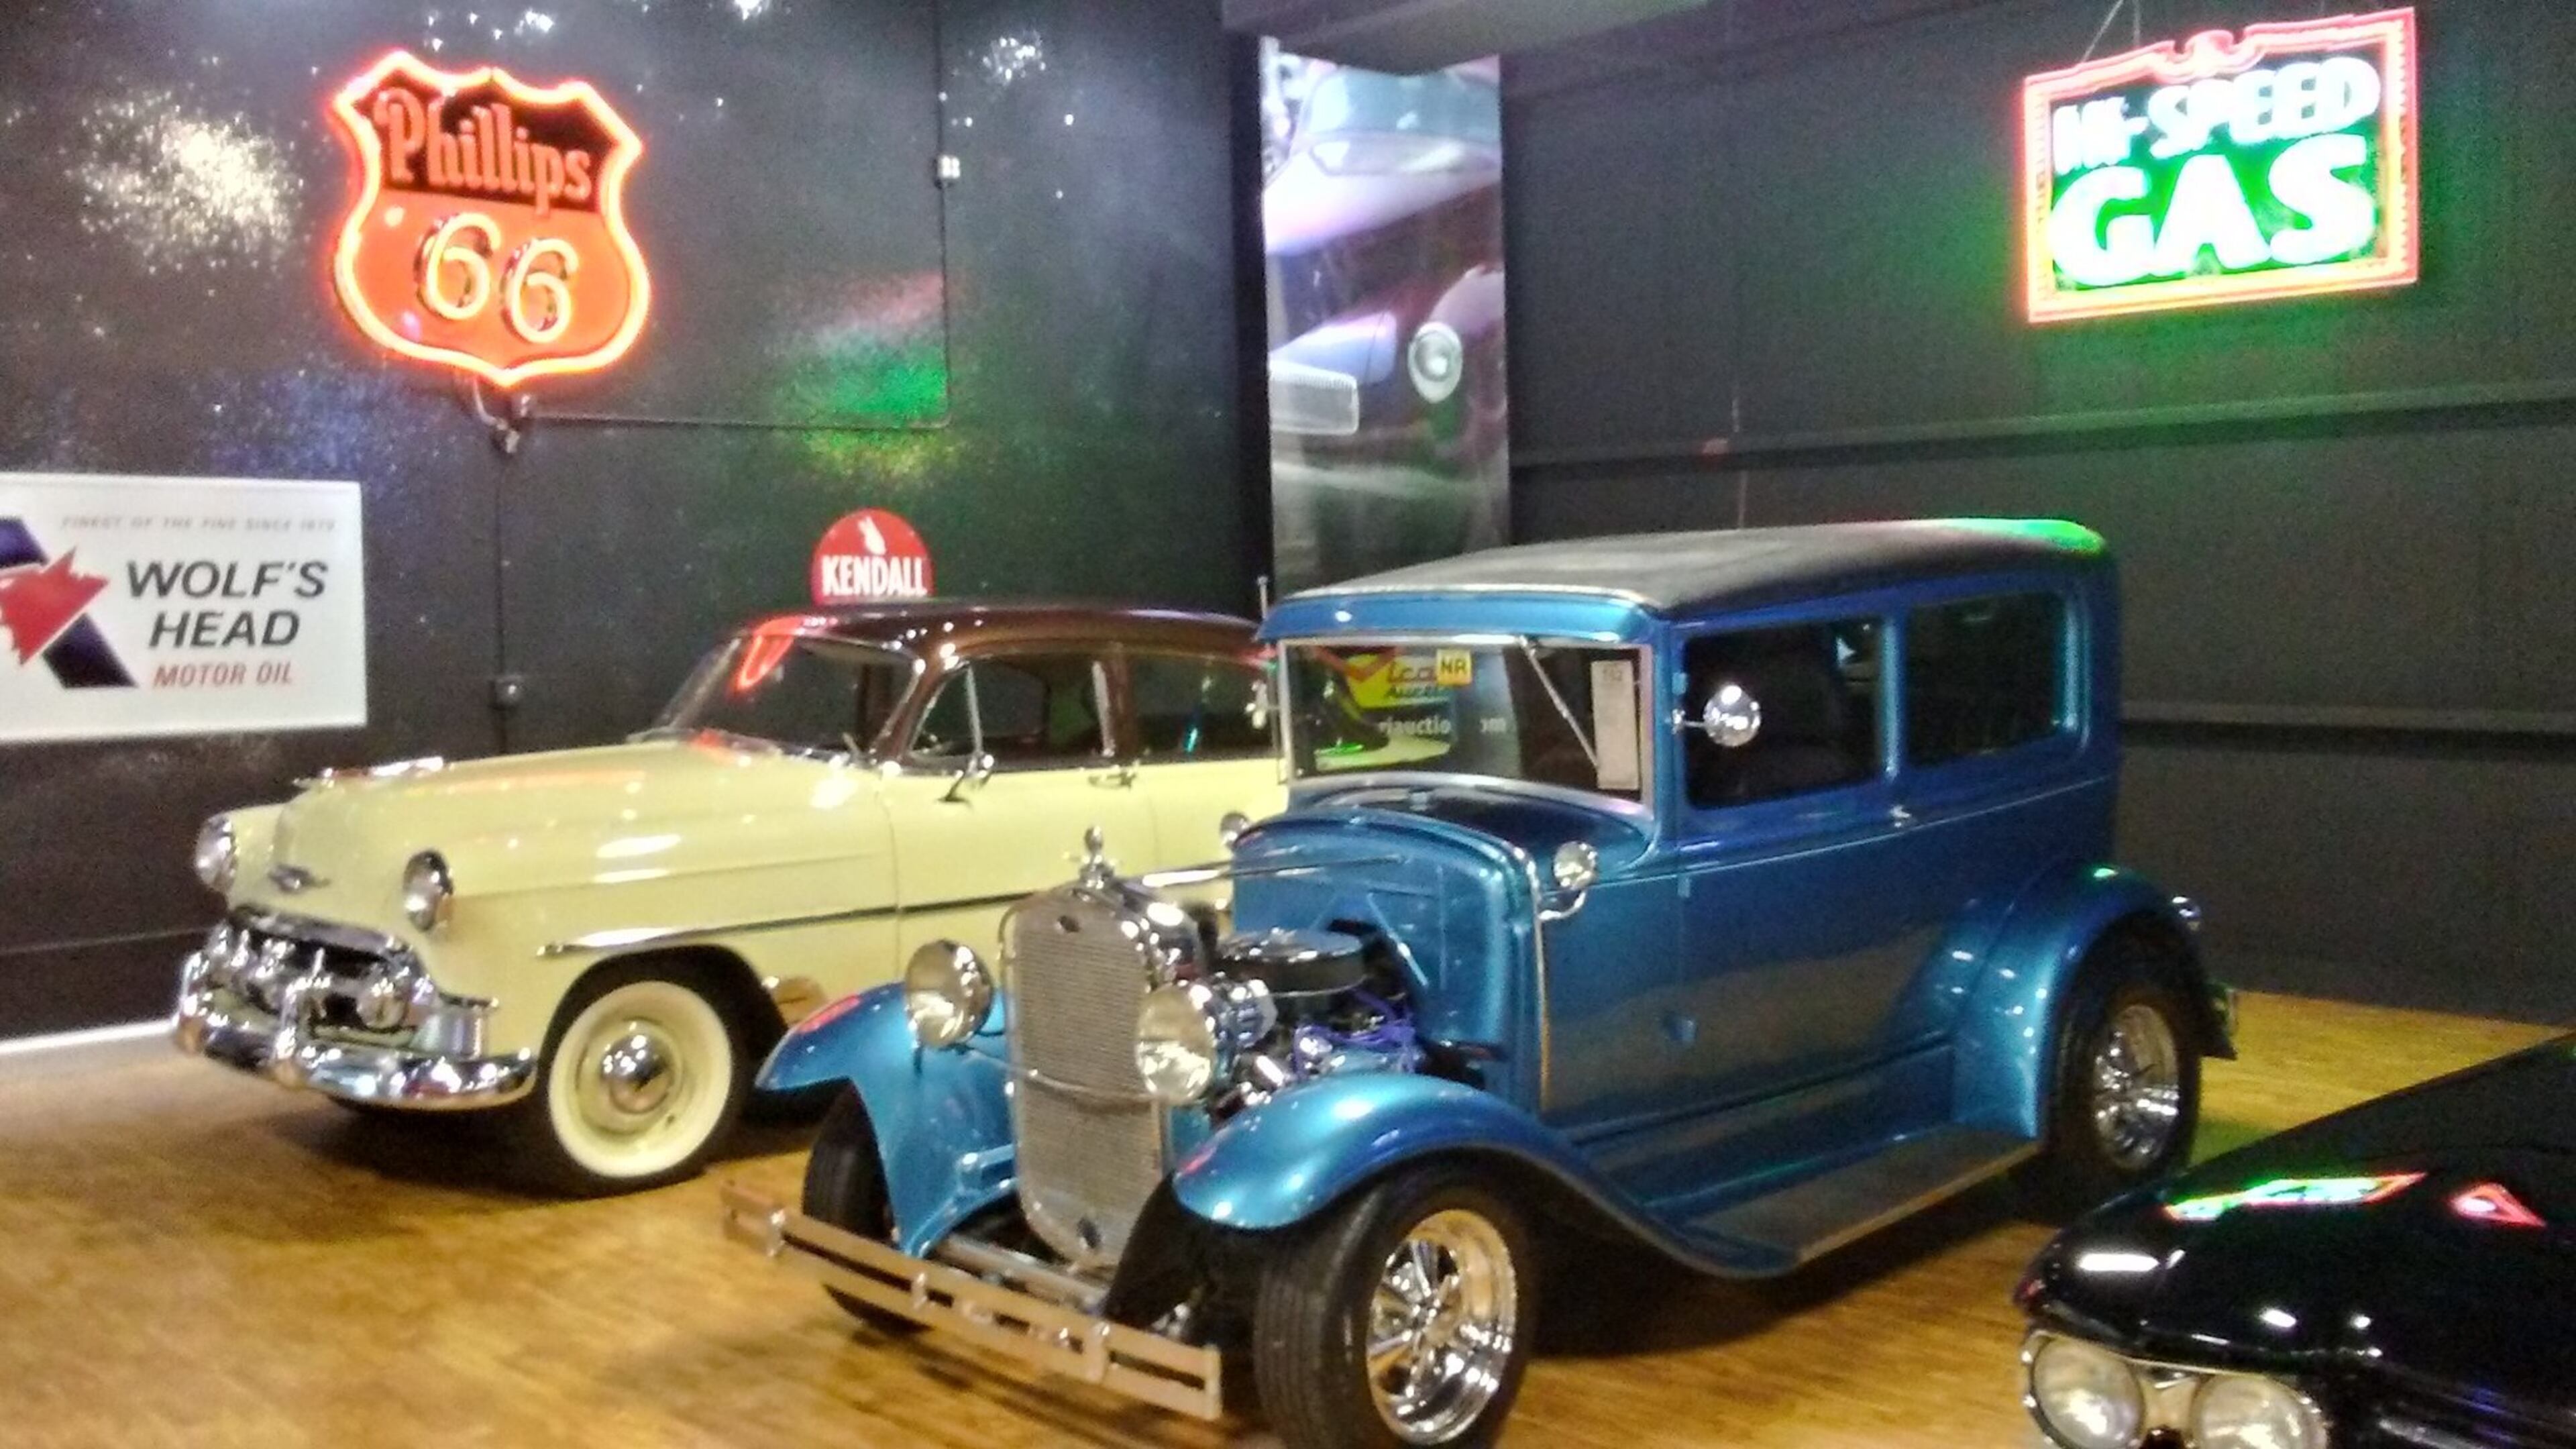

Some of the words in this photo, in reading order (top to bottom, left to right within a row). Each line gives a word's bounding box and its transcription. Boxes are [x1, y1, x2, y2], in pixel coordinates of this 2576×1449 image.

[373, 87, 592, 219] Phillips
[2048, 133, 2376, 286] GAS
[415, 211, 580, 343] 66
[127, 559, 329, 599] WOLF'S
[822, 554, 928, 598] KENDALL
[148, 610, 301, 649] HEAD
[152, 661, 246, 688] MOTOR
[256, 661, 293, 686] OIL
